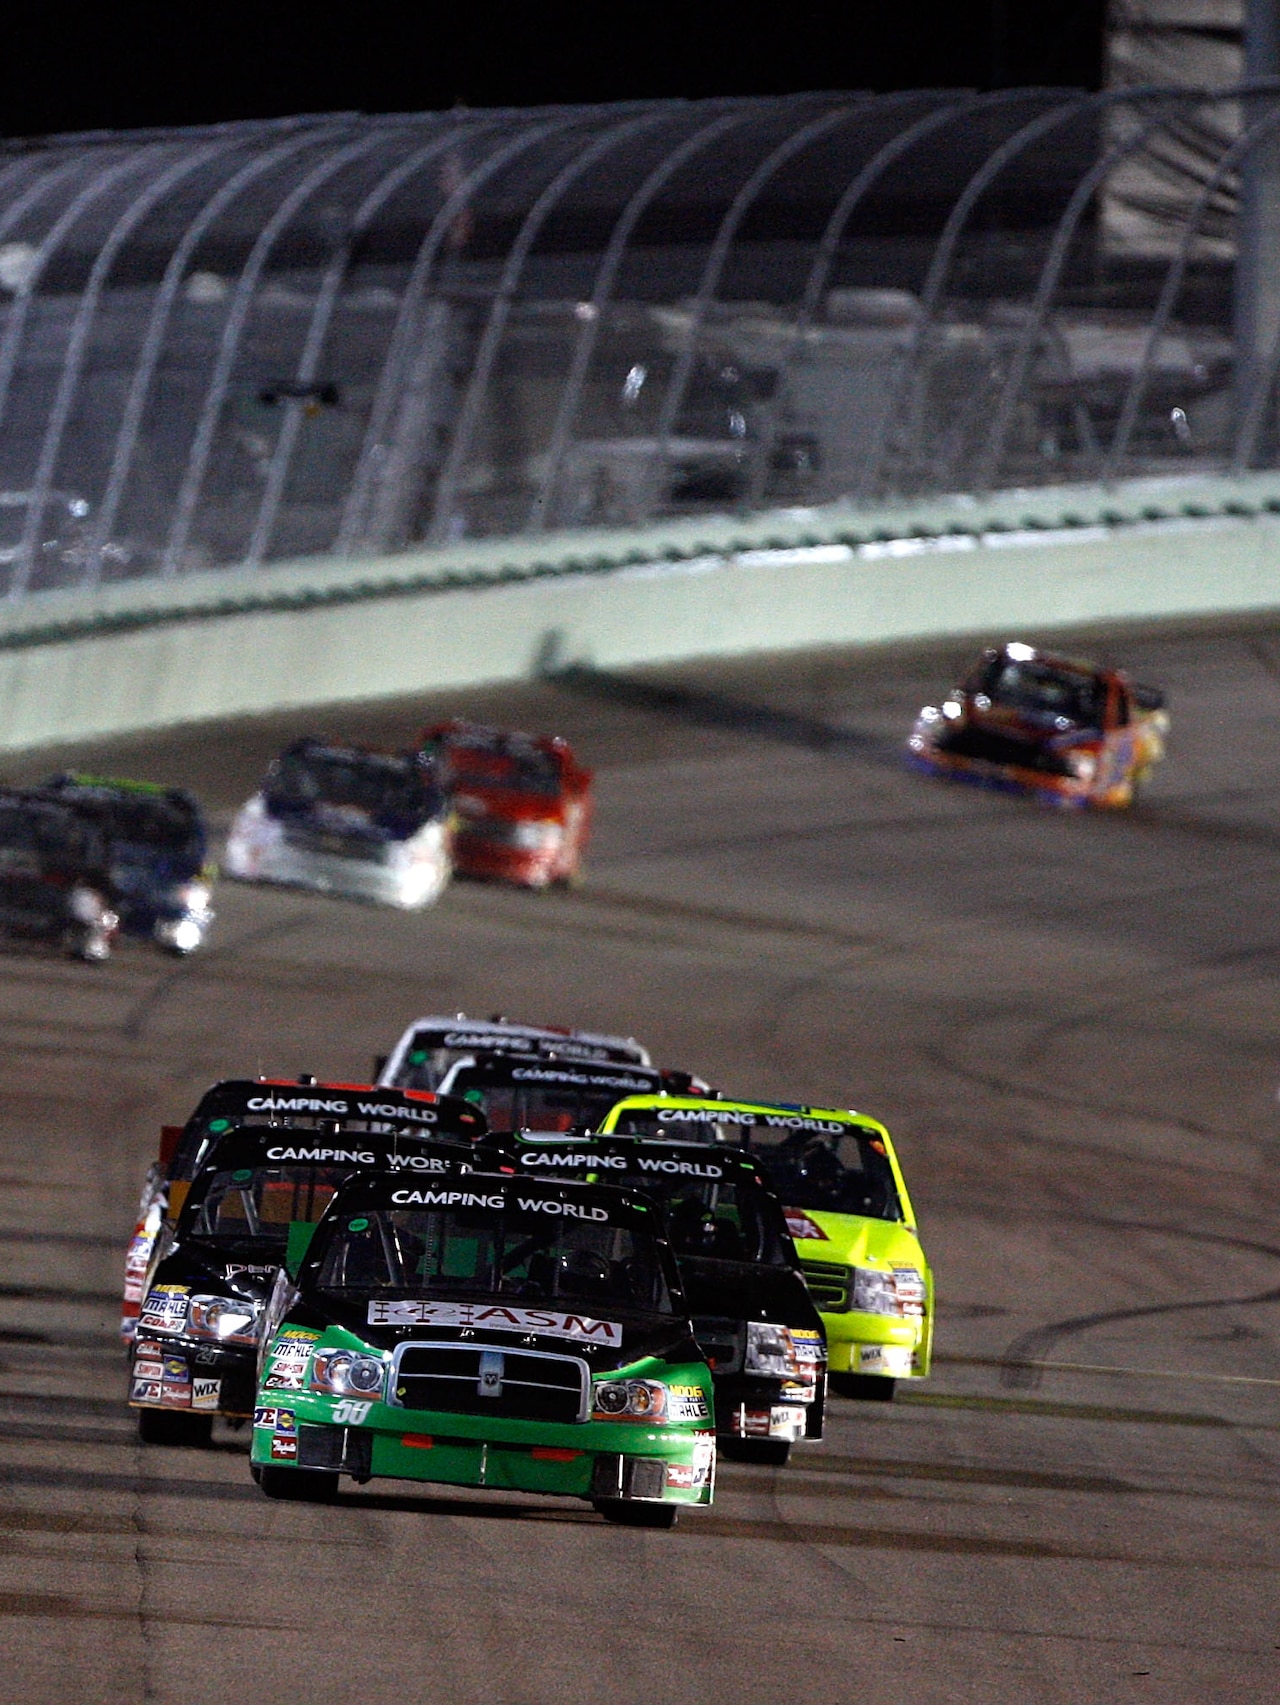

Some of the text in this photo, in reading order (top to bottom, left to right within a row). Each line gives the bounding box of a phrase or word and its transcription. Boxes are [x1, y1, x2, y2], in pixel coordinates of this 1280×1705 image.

[512, 1068, 652, 1090] CAMPING WORLD
[247, 1097, 438, 1123] CAMPING WORLD
[657, 1109, 845, 1135] CAMPING WORLD
[267, 1147, 451, 1171] CAMPING WOR
[521, 1152, 723, 1178] CAMPING WORLD
[391, 1189, 609, 1222] CAMPING WORLD
[147, 1300, 187, 1315] MAHLE
[475, 1307, 616, 1338] ASM
[194, 1382, 219, 1397] WIX
[669, 1385, 704, 1398] MOOG
[772, 1411, 790, 1425] WIX
